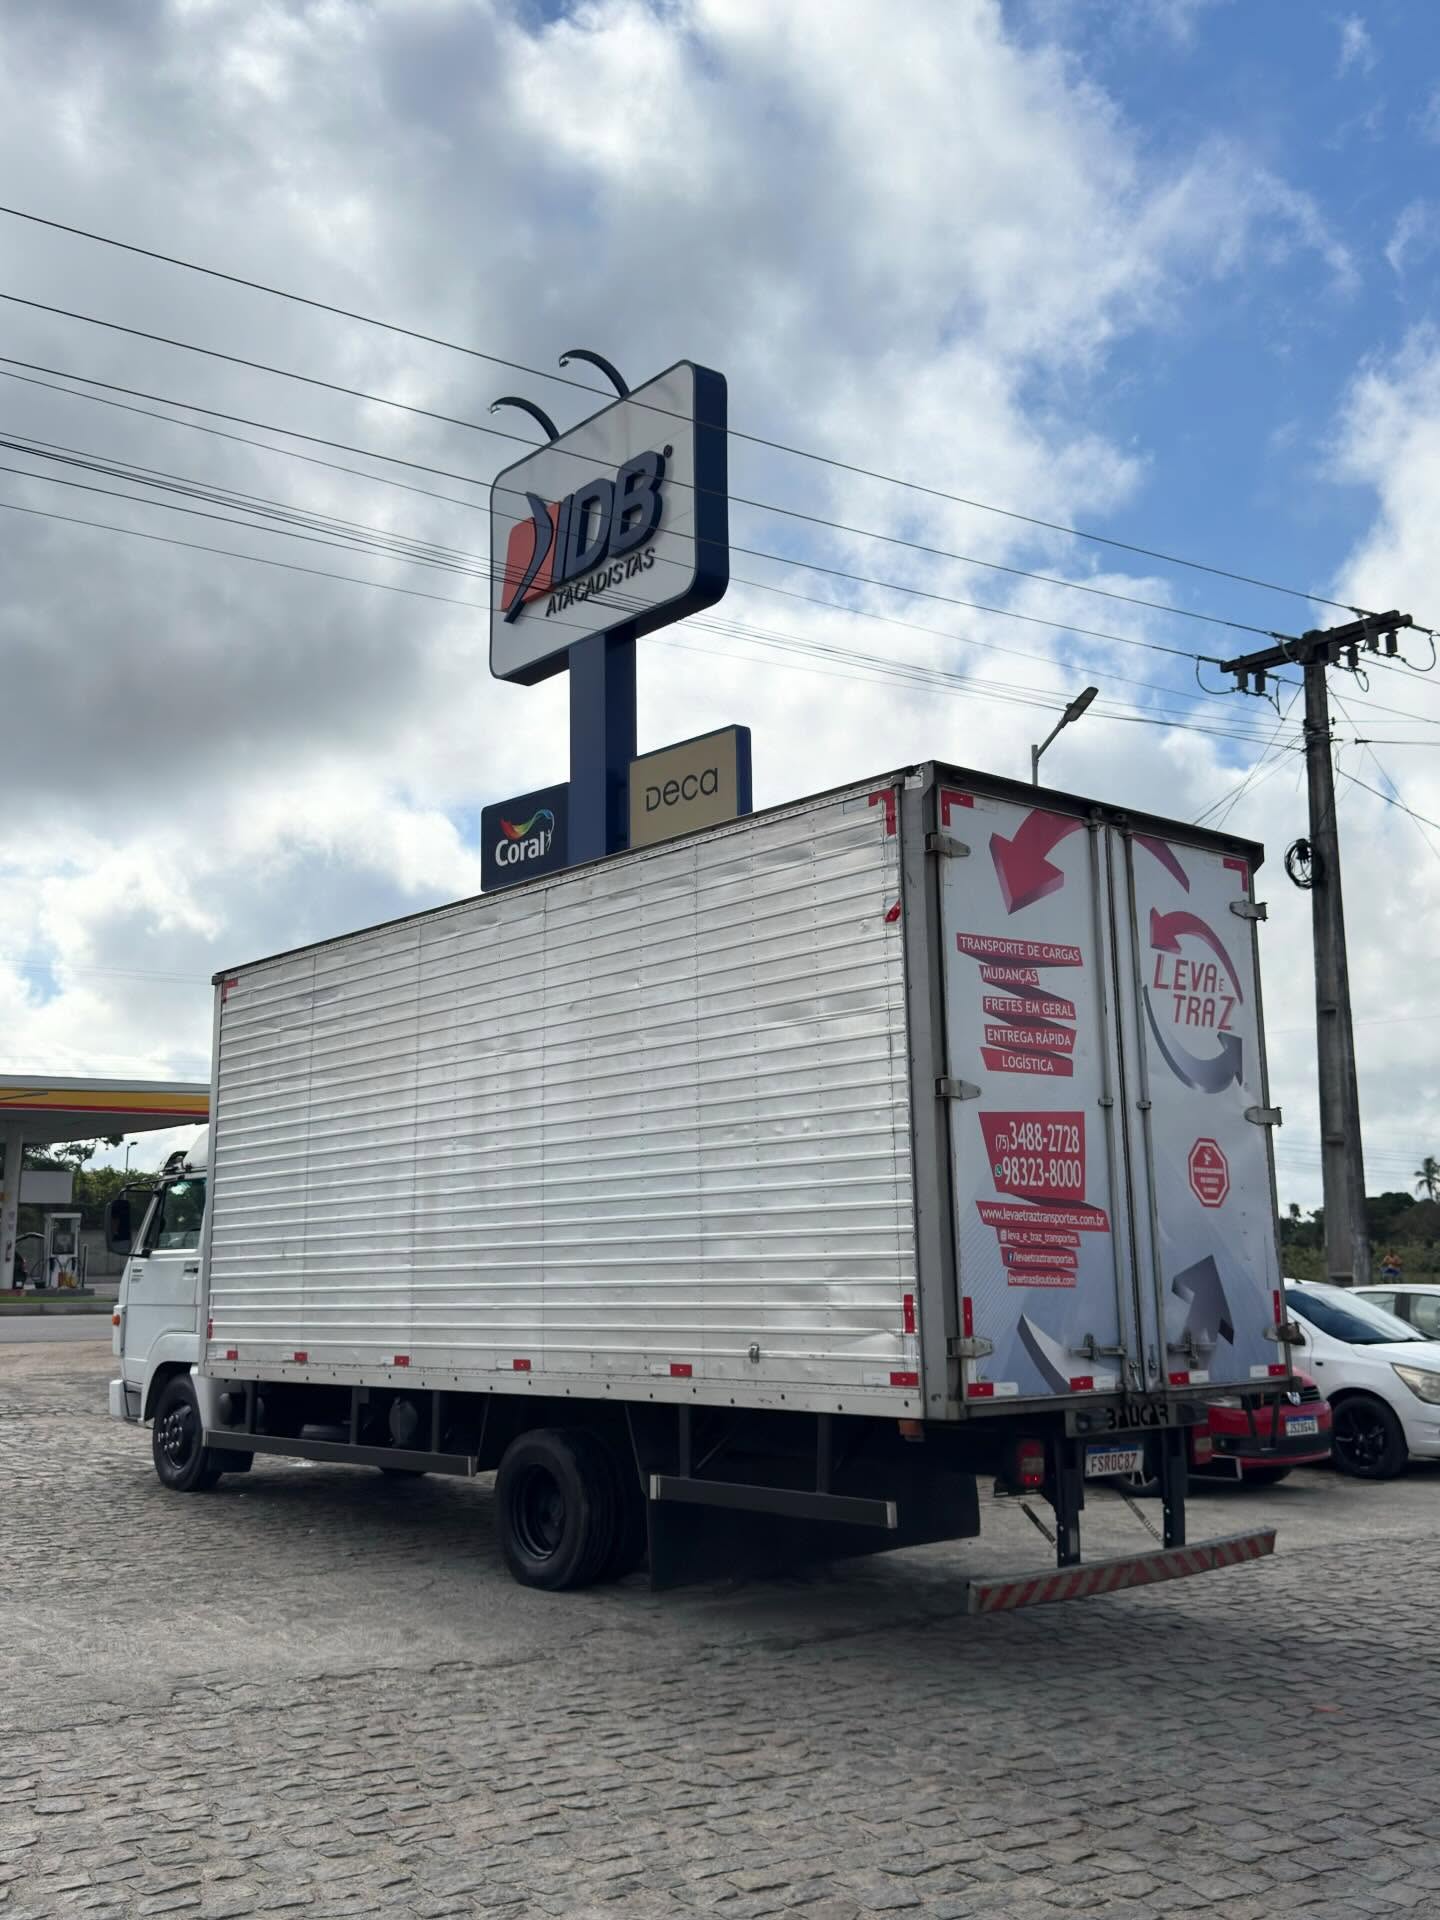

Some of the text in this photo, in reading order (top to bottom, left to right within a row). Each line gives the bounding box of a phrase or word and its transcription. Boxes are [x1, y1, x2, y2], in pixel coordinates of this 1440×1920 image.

[546, 547, 656, 617] ATACADISTAS
[495, 831, 545, 867] Coral
[959, 936, 1080, 962] TRANSPORTE DE CARGAS
[982, 966, 1038, 984] MUDANÇAS
[1153, 953, 1225, 993] LEVA E
[985, 997, 1074, 1017] FRETES EM GERAL
[1173, 993, 1236, 1031] TRAZ
[987, 1028, 1072, 1046] ENTREGA RÁPIDA
[1002, 1055, 1054, 1072] LOGÍSTICA
[995, 1120, 1080, 1153] (75) 3488-2728
[1002, 1156, 1082, 1188] 98323-8000
